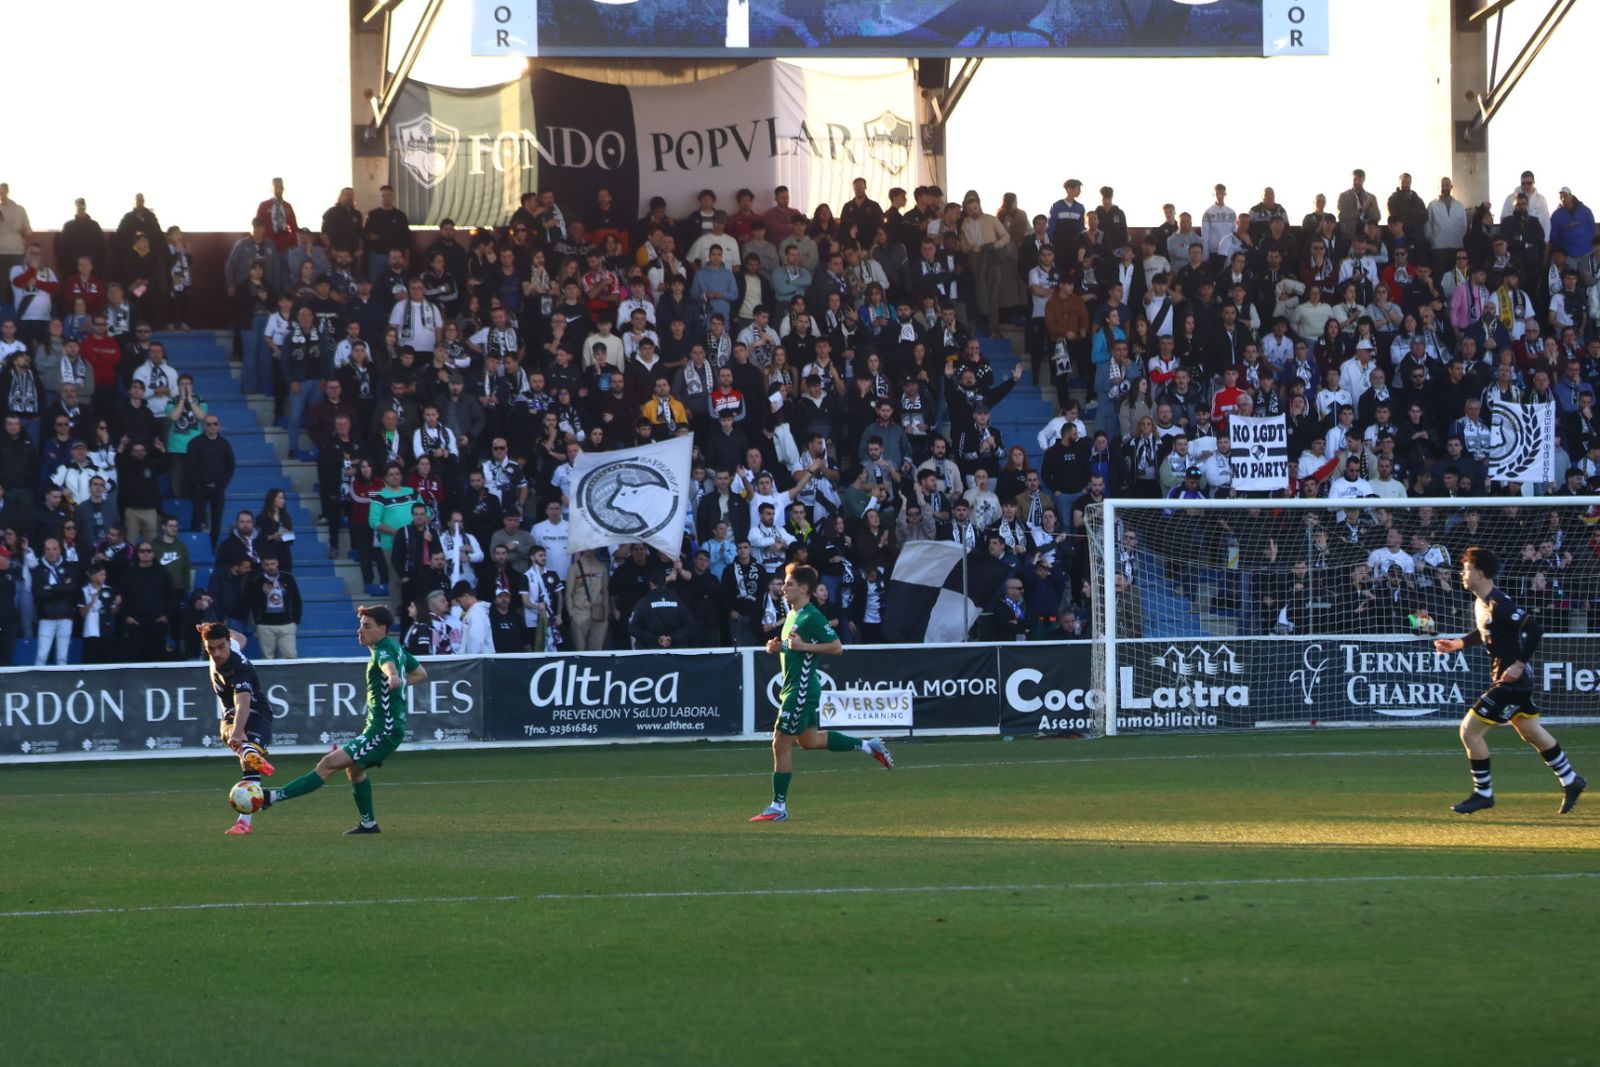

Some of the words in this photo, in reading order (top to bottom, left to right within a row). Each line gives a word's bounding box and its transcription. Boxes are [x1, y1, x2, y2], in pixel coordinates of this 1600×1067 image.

[1288, 0, 1304, 47] OR
[468, 126, 625, 175] FONDO
[650, 116, 863, 172] POPVLAR
[1232, 424, 1250, 443] NO
[1232, 462, 1248, 479] NO
[1250, 461, 1288, 479] PARTY
[1340, 644, 1470, 673] TERNERA
[923, 678, 998, 697] MOTOR
[1119, 666, 1250, 709] Lastra
[1347, 675, 1465, 706] CHARRA
[0, 679, 124, 727] RDÓN
[146, 687, 198, 722] DE
[308, 680, 474, 717] FRLES
[839, 695, 909, 711] VERSUS
[552, 708, 621, 721] PREVENCION
[624, 708, 630, 719] Y
[670, 706, 721, 718] LABORAL
[848, 711, 904, 720] E-LEARNING
[1038, 715, 1102, 730] Asesor
[1116, 711, 1218, 728] nmobiliaria
[523, 724, 548, 736] Tfno.
[550, 723, 598, 735] 923616845
[636, 720, 705, 731] www.althea.es
